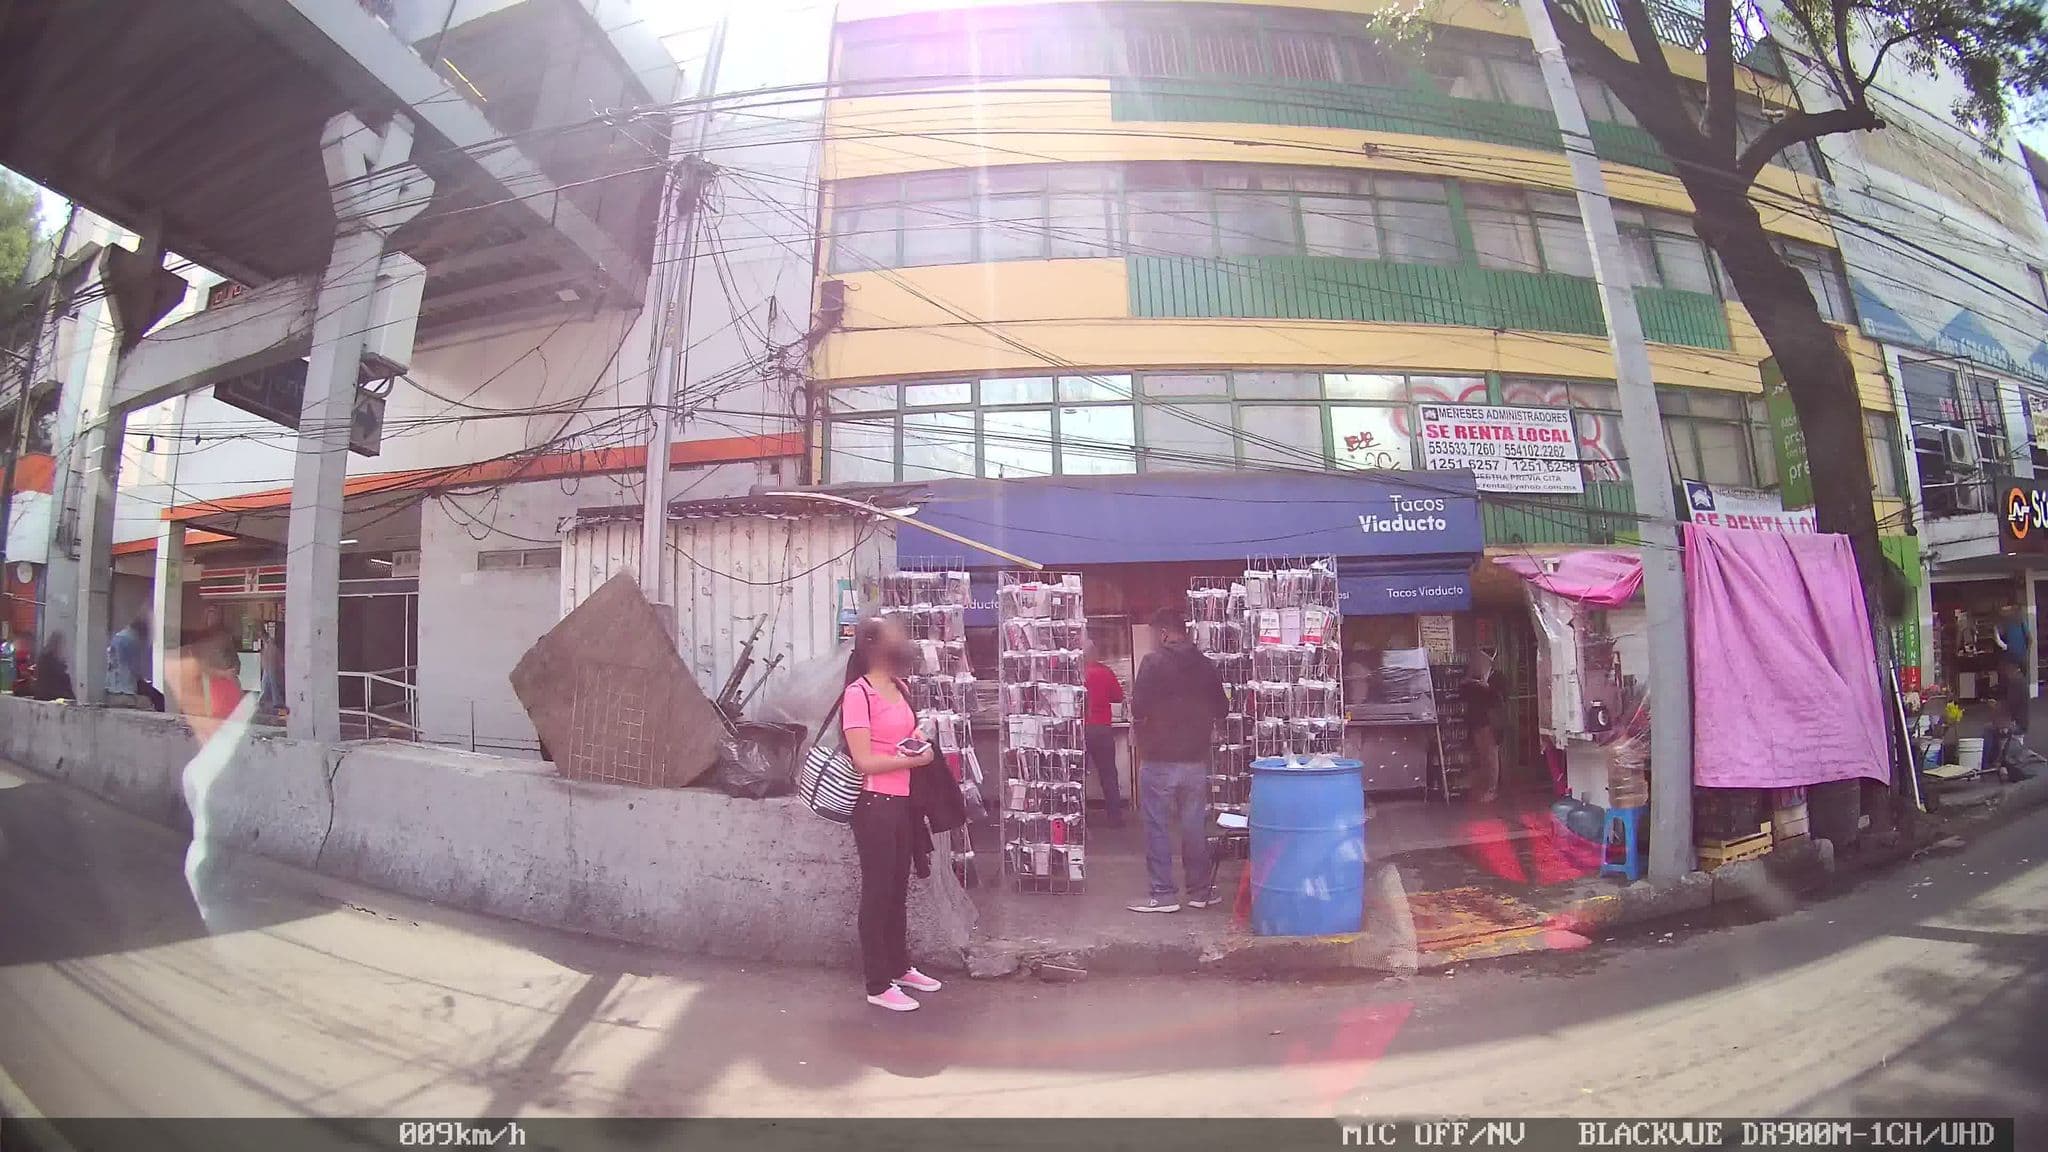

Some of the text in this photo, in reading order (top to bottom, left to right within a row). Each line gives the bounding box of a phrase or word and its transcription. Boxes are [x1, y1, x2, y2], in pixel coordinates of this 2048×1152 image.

[1438, 408, 1568, 423] MENESES ADMINISTRADORES
[1426, 424, 1571, 443] SE RENTA LOCAL
[1389, 494, 1445, 512] Tacos
[1358, 513, 1446, 533] Viaducto
[1386, 585, 1464, 598] Tacos Viaducto
